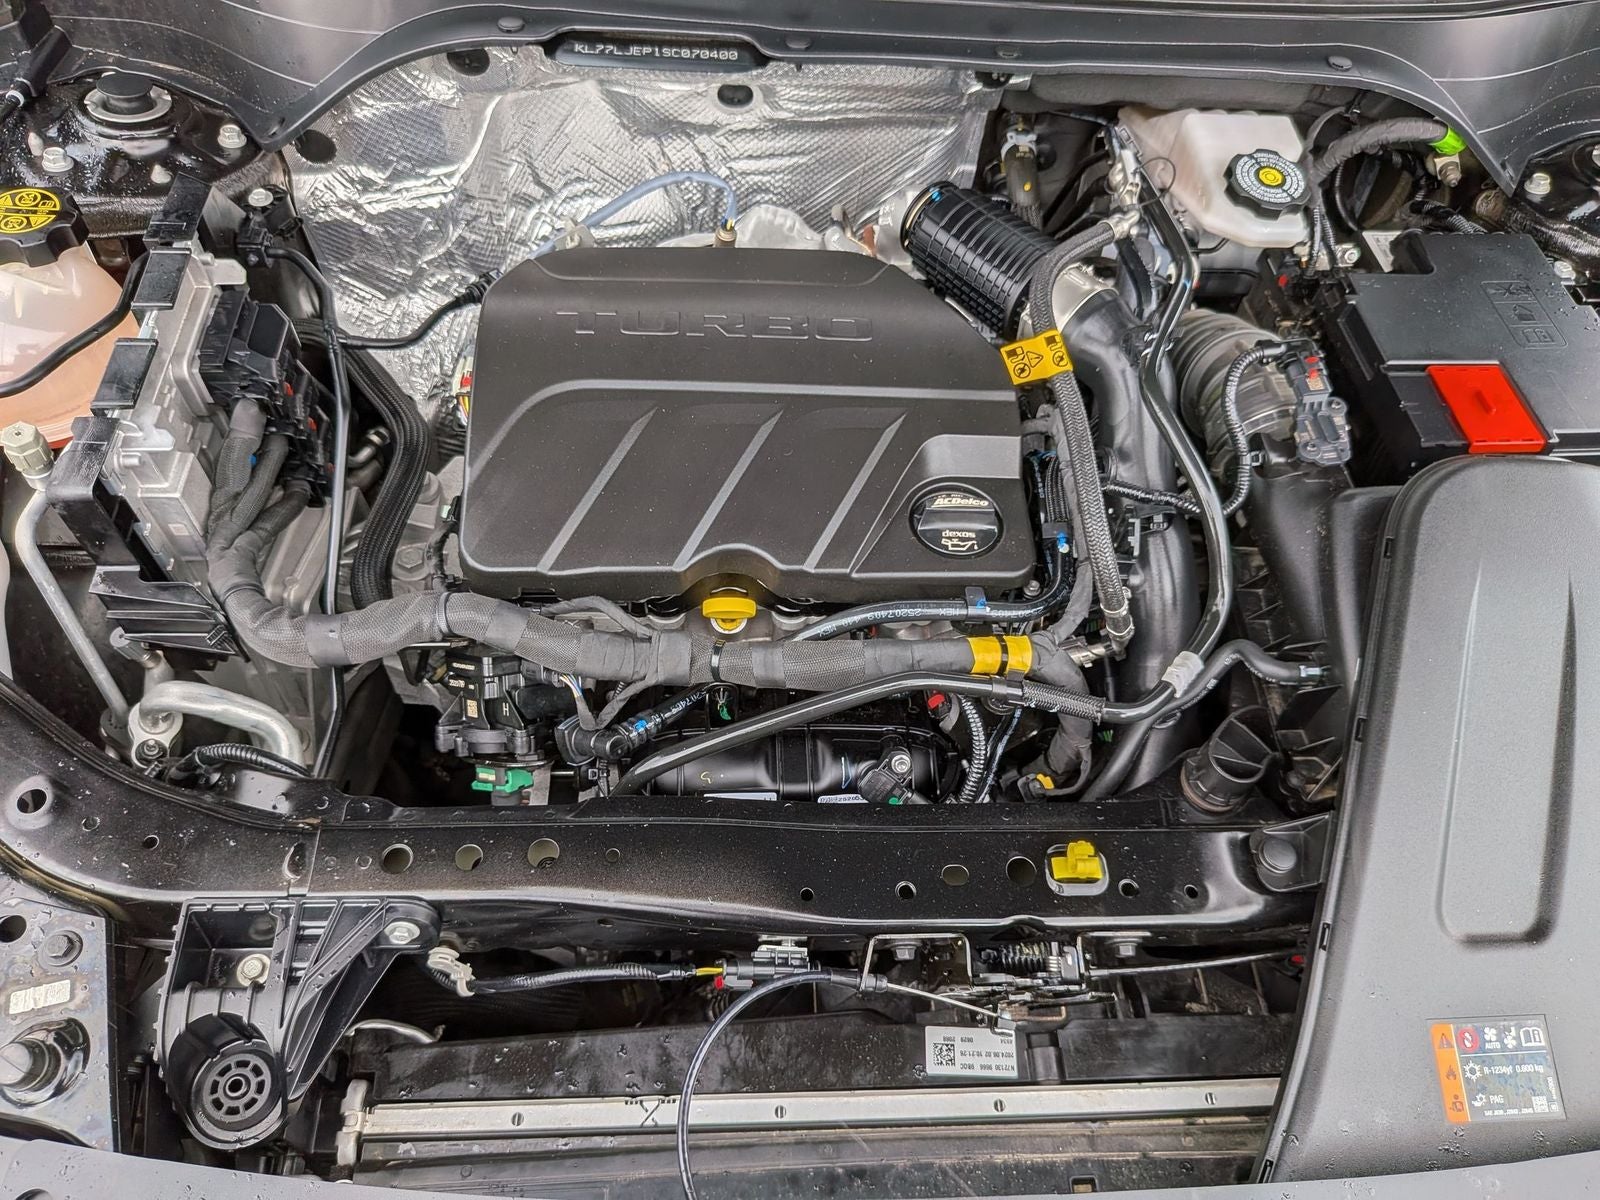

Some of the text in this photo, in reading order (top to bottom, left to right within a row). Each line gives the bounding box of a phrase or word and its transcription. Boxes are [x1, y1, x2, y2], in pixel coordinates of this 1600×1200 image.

[574, 43, 738, 60] KL77LJEP1SC070400
[556, 311, 873, 341] TURBO
[934, 497, 989, 507] ACDelco
[942, 529, 976, 538] dexos
[502, 702, 510, 717] H
[1483, 1064, 1513, 1075] R-1234yf
[1534, 1063, 1544, 1074] kg
[1489, 1095, 1504, 1104] PAG
